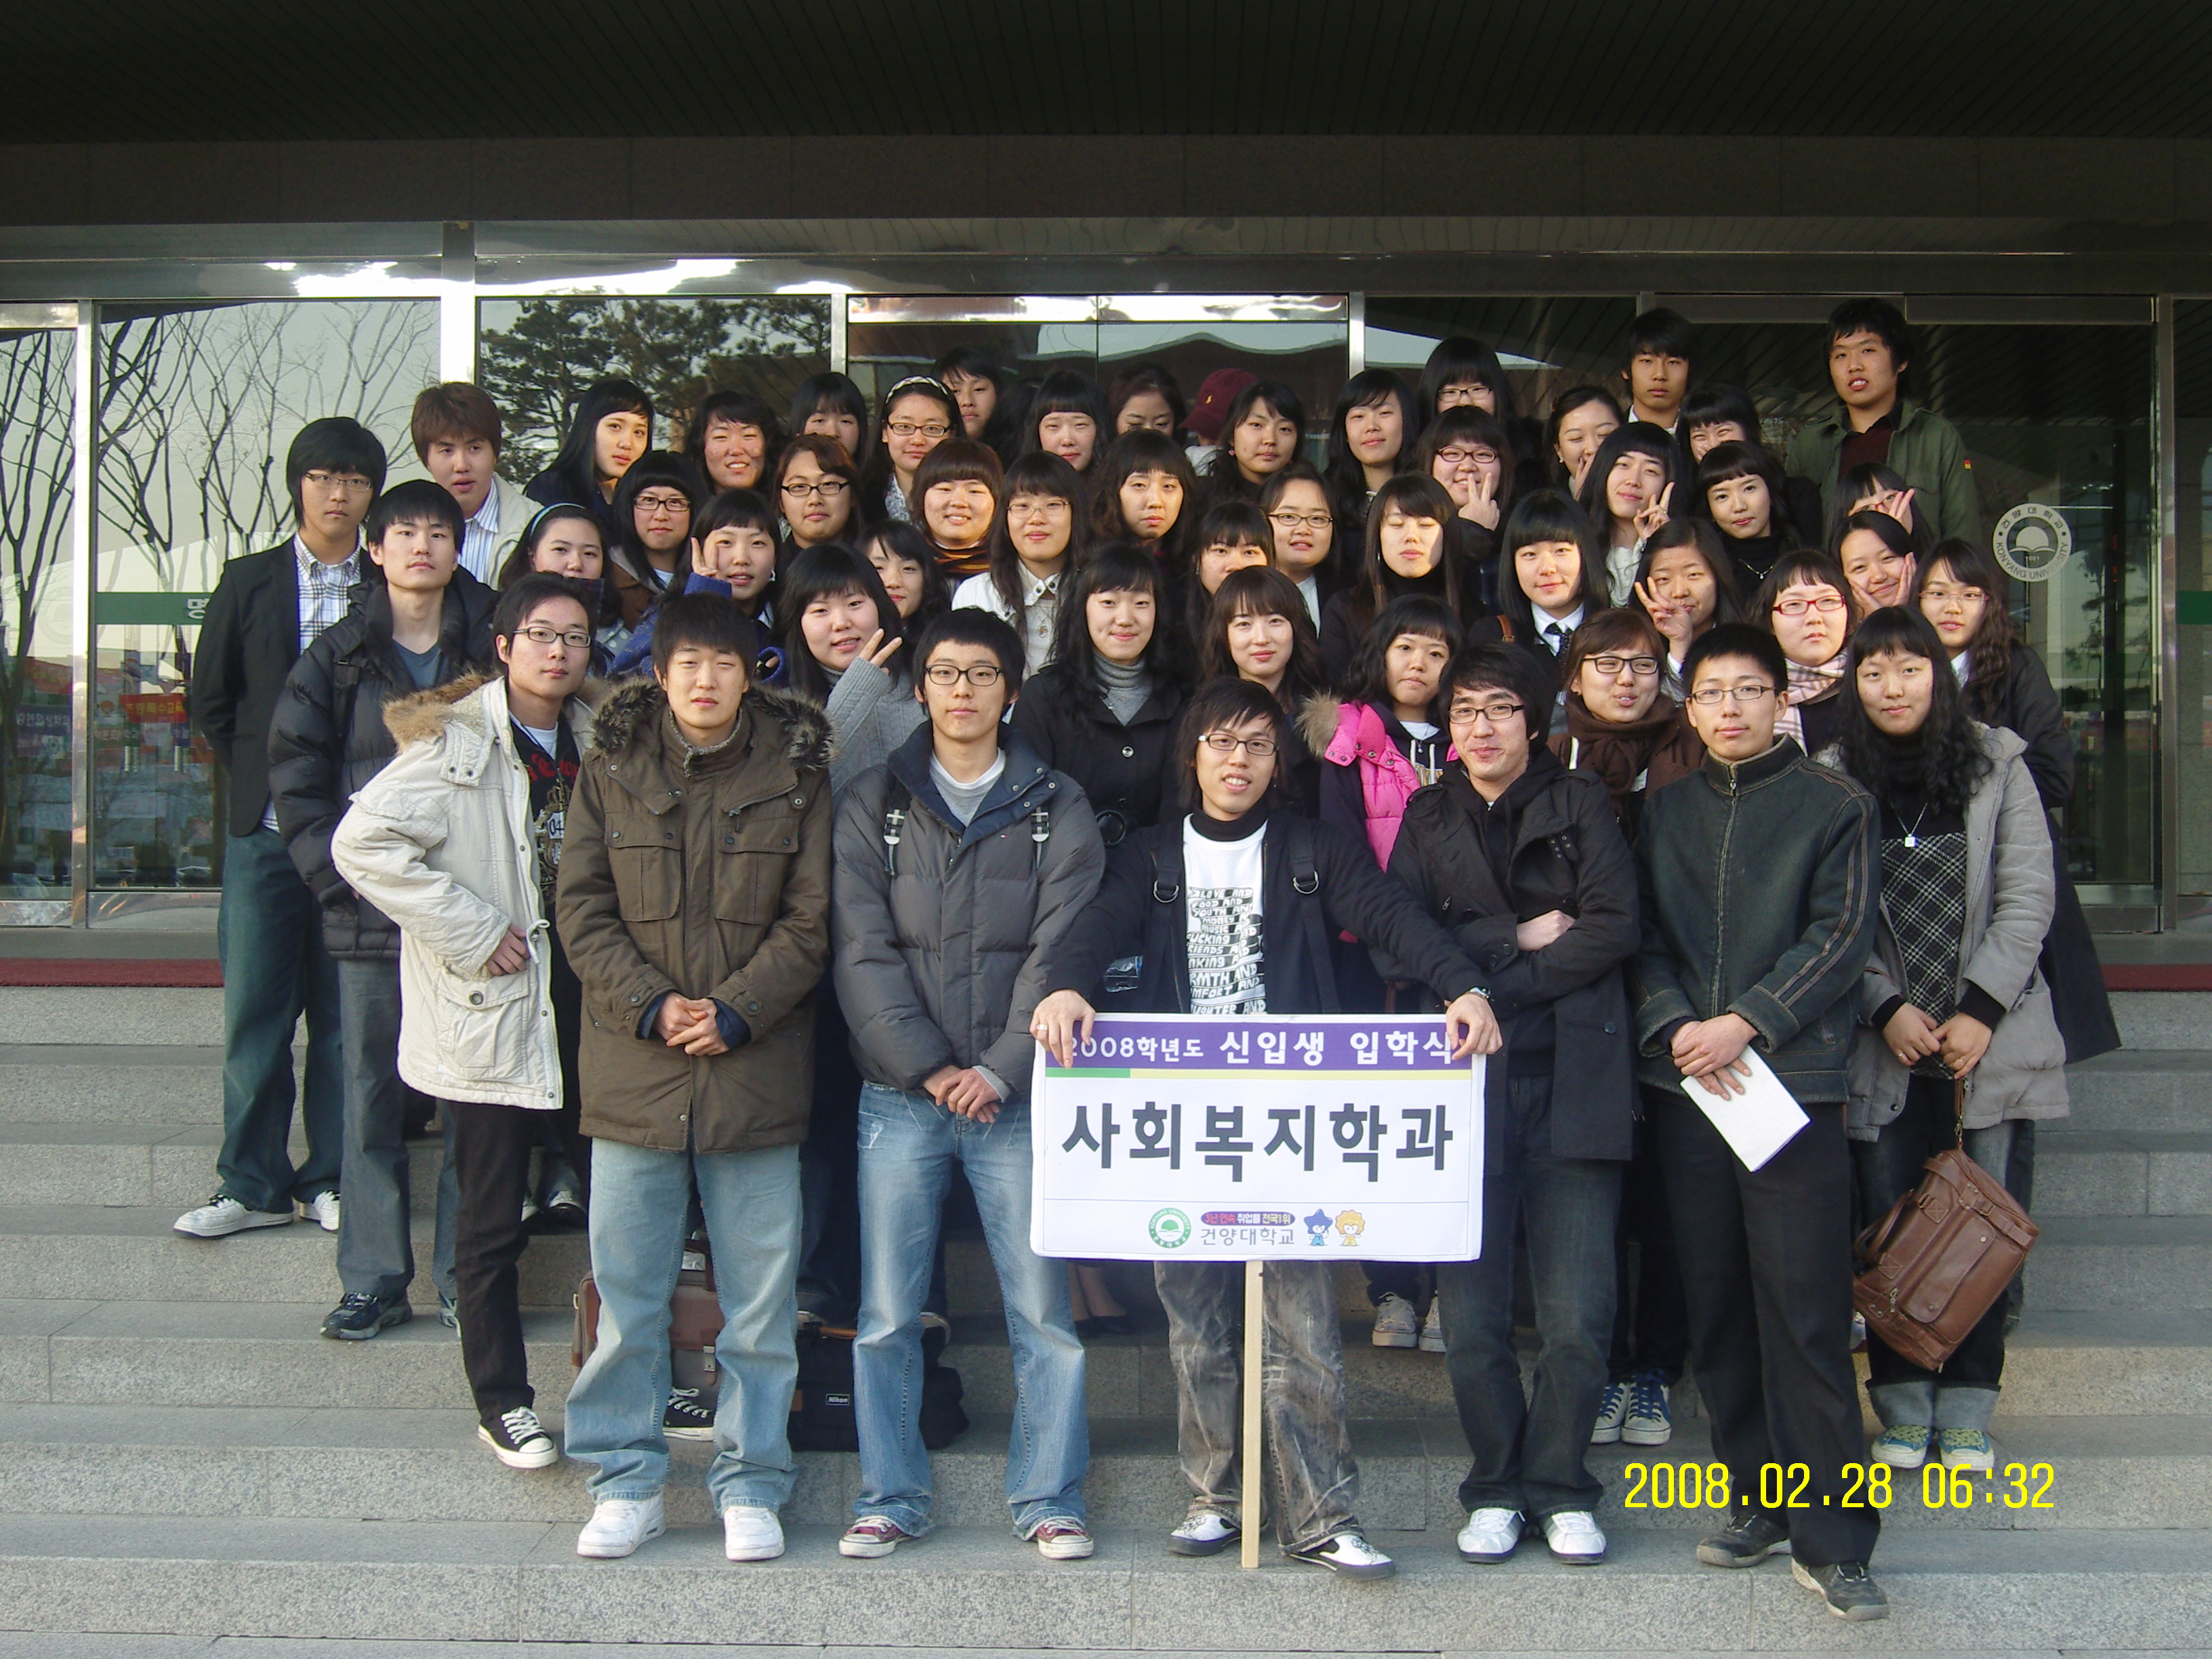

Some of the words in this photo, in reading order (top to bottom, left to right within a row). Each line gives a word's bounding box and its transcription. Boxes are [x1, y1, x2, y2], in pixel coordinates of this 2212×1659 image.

[1996, 541, 2027, 579] KONYANG
[2028, 541, 2069, 579] UNIVSITY
[1200, 889, 1226, 899] LOVE
[1232, 888, 1253, 898] AND
[1223, 897, 1244, 907] AND
[1193, 908, 1227, 918] YOUTH
[1186, 943, 1224, 955] RIENDS
[1189, 971, 1230, 987] RMTH
[1234, 963, 1258, 981] AND
[1190, 985, 1233, 999] MFORT
[1237, 976, 1260, 991] AND
[1219, 1030, 1325, 1065] 신입생
[1349, 1030, 1451, 1065] 입학식
[1061, 1101, 1454, 1183] 사회복지학과
[1200, 1227, 1295, 1246] 건양대학교
